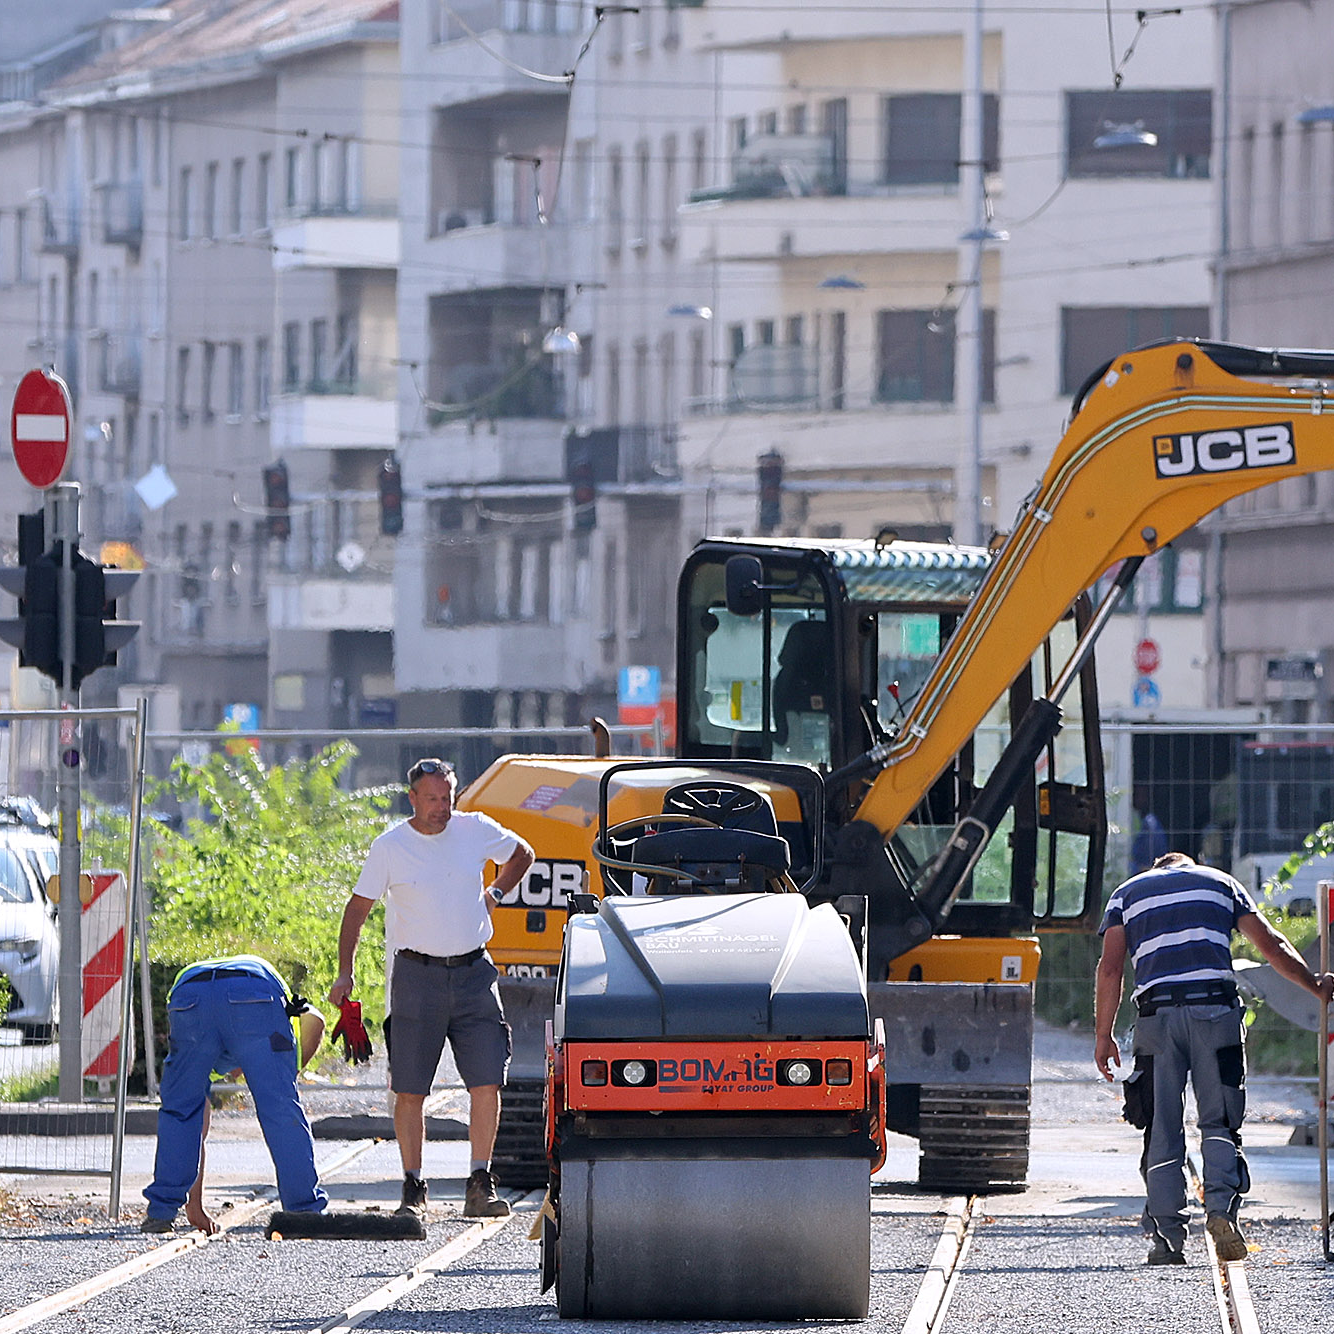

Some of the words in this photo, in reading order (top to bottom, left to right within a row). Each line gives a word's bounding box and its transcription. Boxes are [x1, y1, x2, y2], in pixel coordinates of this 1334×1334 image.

[1157, 425, 1293, 476] JCB
[627, 665, 651, 697] P
[644, 934, 779, 943] SCHMITTNÄGEL
[737, 1085, 774, 1093] GROUP
